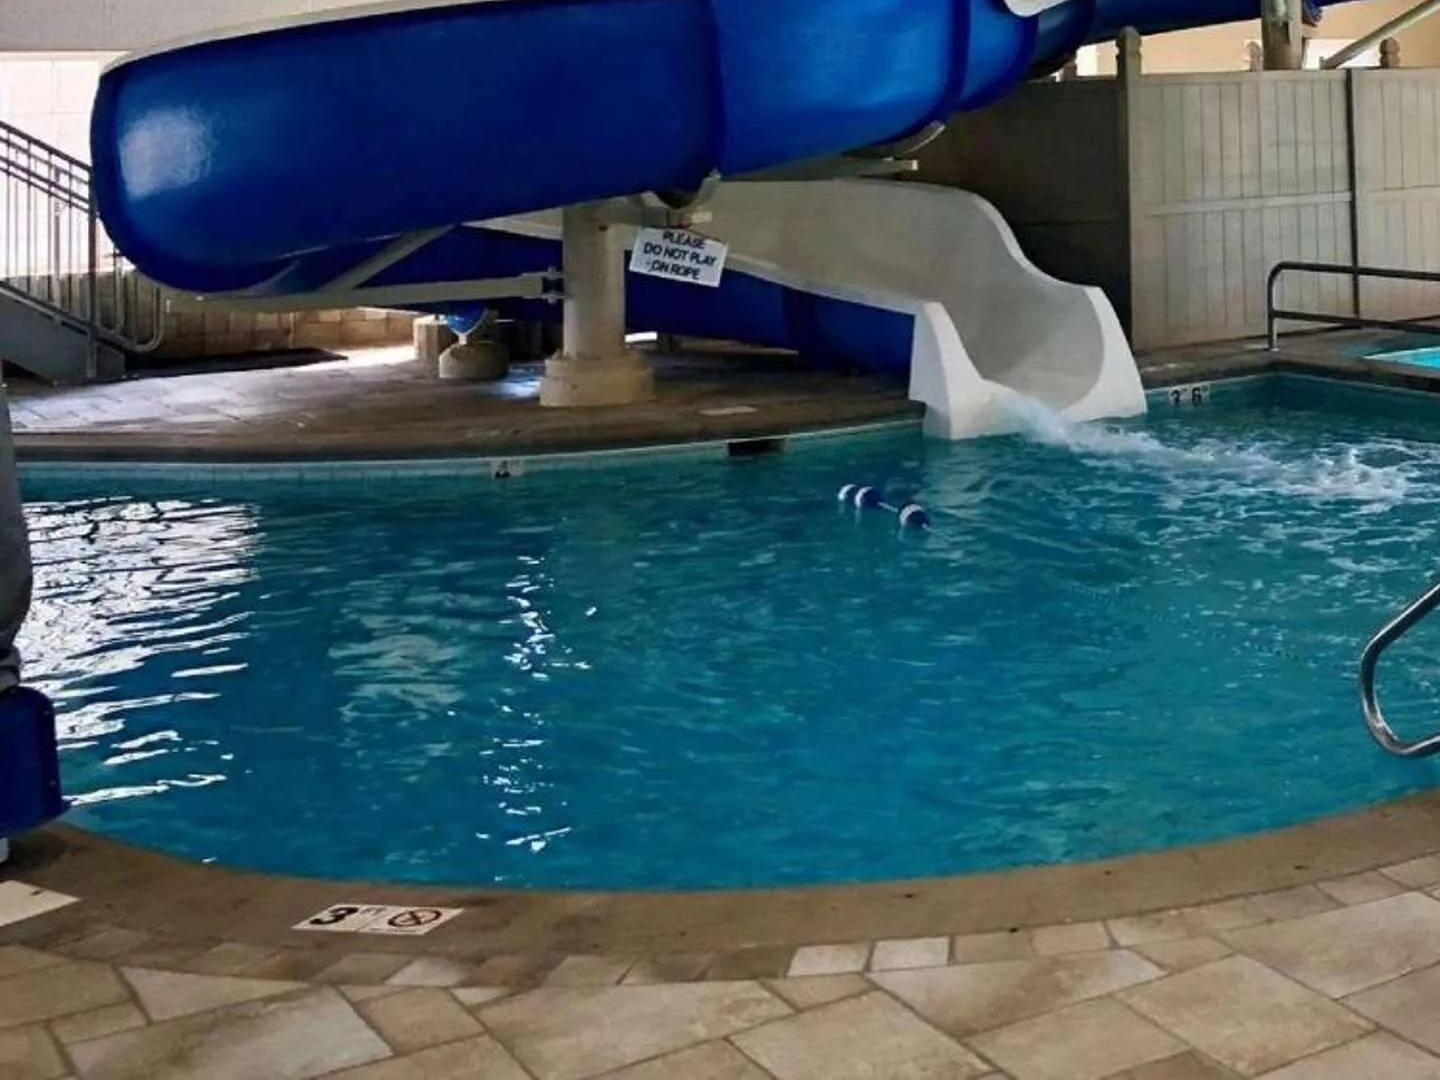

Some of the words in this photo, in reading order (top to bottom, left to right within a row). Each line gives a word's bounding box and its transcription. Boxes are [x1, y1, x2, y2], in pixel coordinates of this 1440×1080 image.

[663, 230, 705, 249] PLEASE
[643, 241, 663, 255] DO
[664, 245, 689, 260] NOT
[690, 251, 717, 266] PLAY
[671, 263, 701, 280] ROPE
[309, 907, 359, 925] 3
